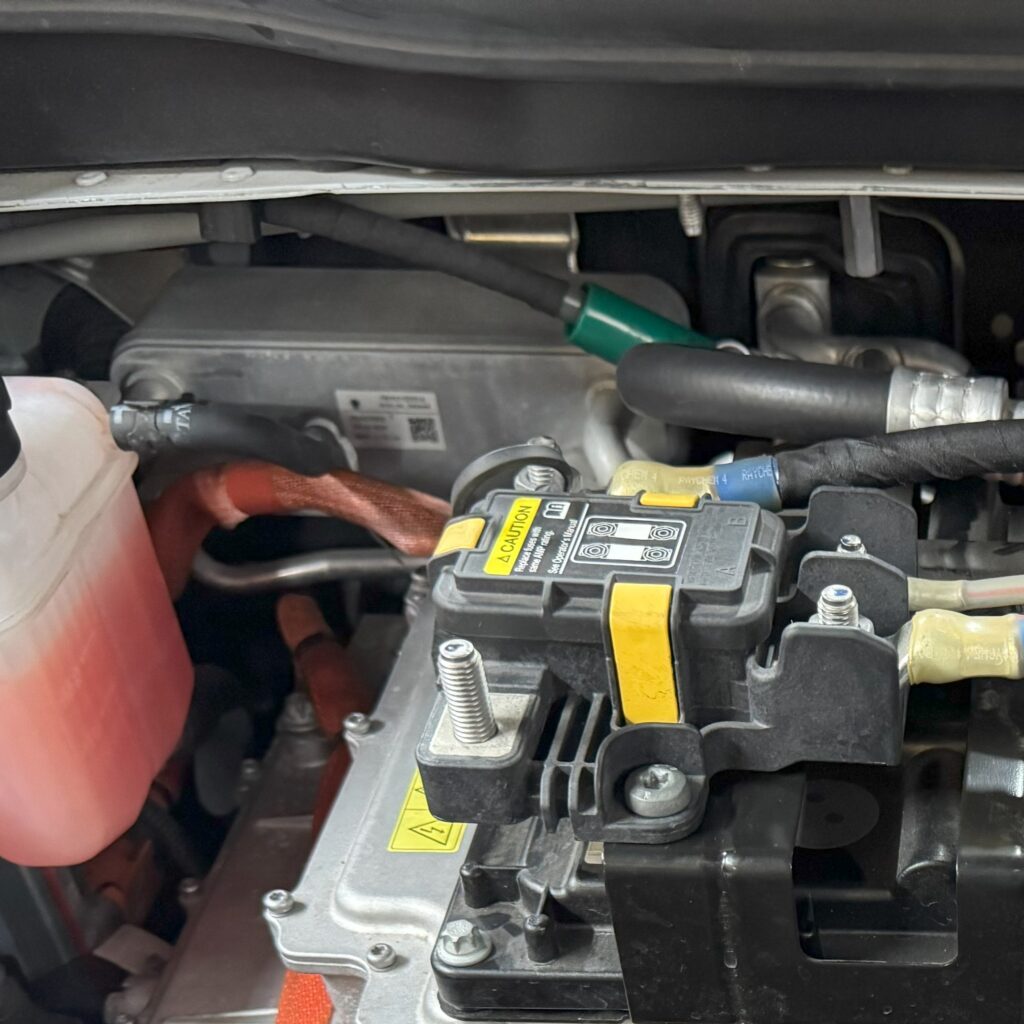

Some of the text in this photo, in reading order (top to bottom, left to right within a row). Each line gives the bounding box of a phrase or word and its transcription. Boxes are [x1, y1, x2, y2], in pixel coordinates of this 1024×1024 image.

[500, 505, 532, 553] CAUTION
[514, 526, 542, 573] Replace fuses with
[547, 519, 578, 574] See Operator's Manual
[529, 555, 541, 573] same
[535, 545, 546, 558] AMP
